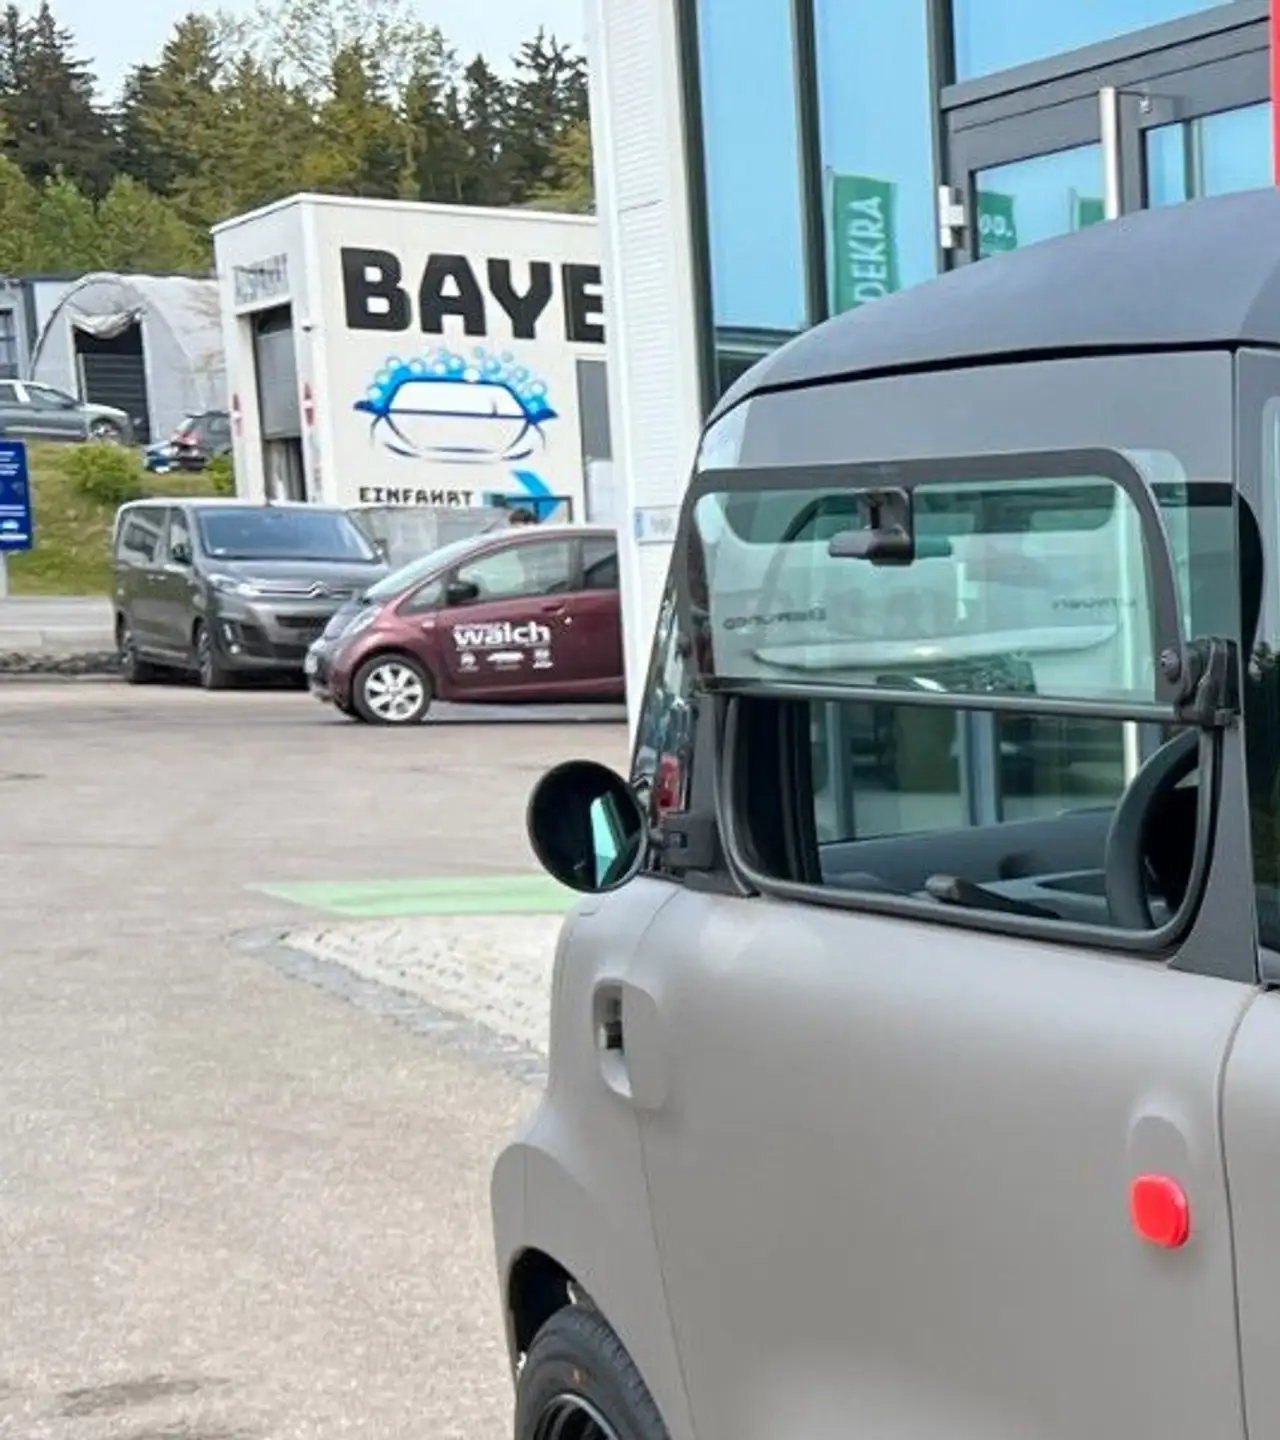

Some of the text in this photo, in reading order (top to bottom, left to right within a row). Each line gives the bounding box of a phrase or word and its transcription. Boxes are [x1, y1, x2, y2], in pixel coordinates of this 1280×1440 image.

[846, 195, 890, 302] DEKRA
[340, 247, 606, 344] BAYE
[359, 487, 474, 507] EINFAHRT
[453, 621, 551, 645] walch
